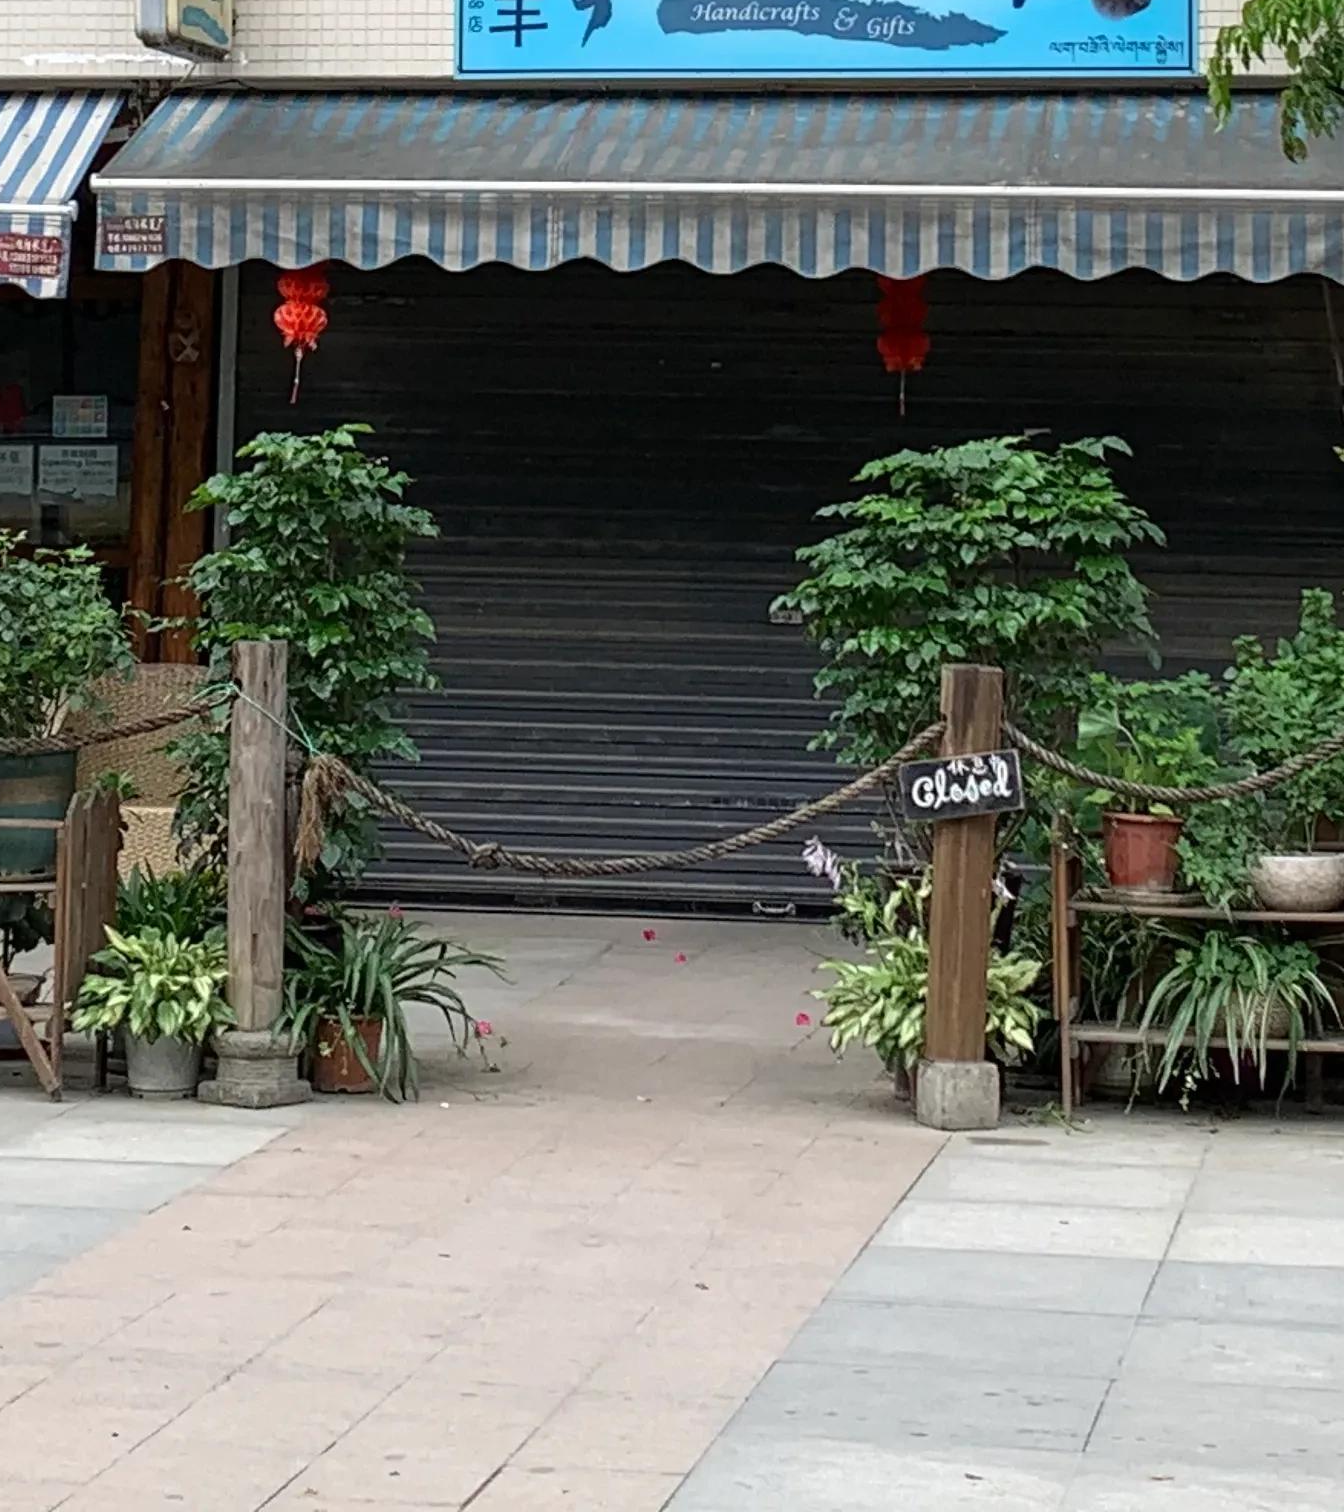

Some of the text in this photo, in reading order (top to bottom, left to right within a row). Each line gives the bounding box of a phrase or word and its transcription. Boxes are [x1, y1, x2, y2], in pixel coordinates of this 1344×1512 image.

[690, 0, 916, 39] Handicrafts & Gifts
[911, 760, 1013, 810] Closed
